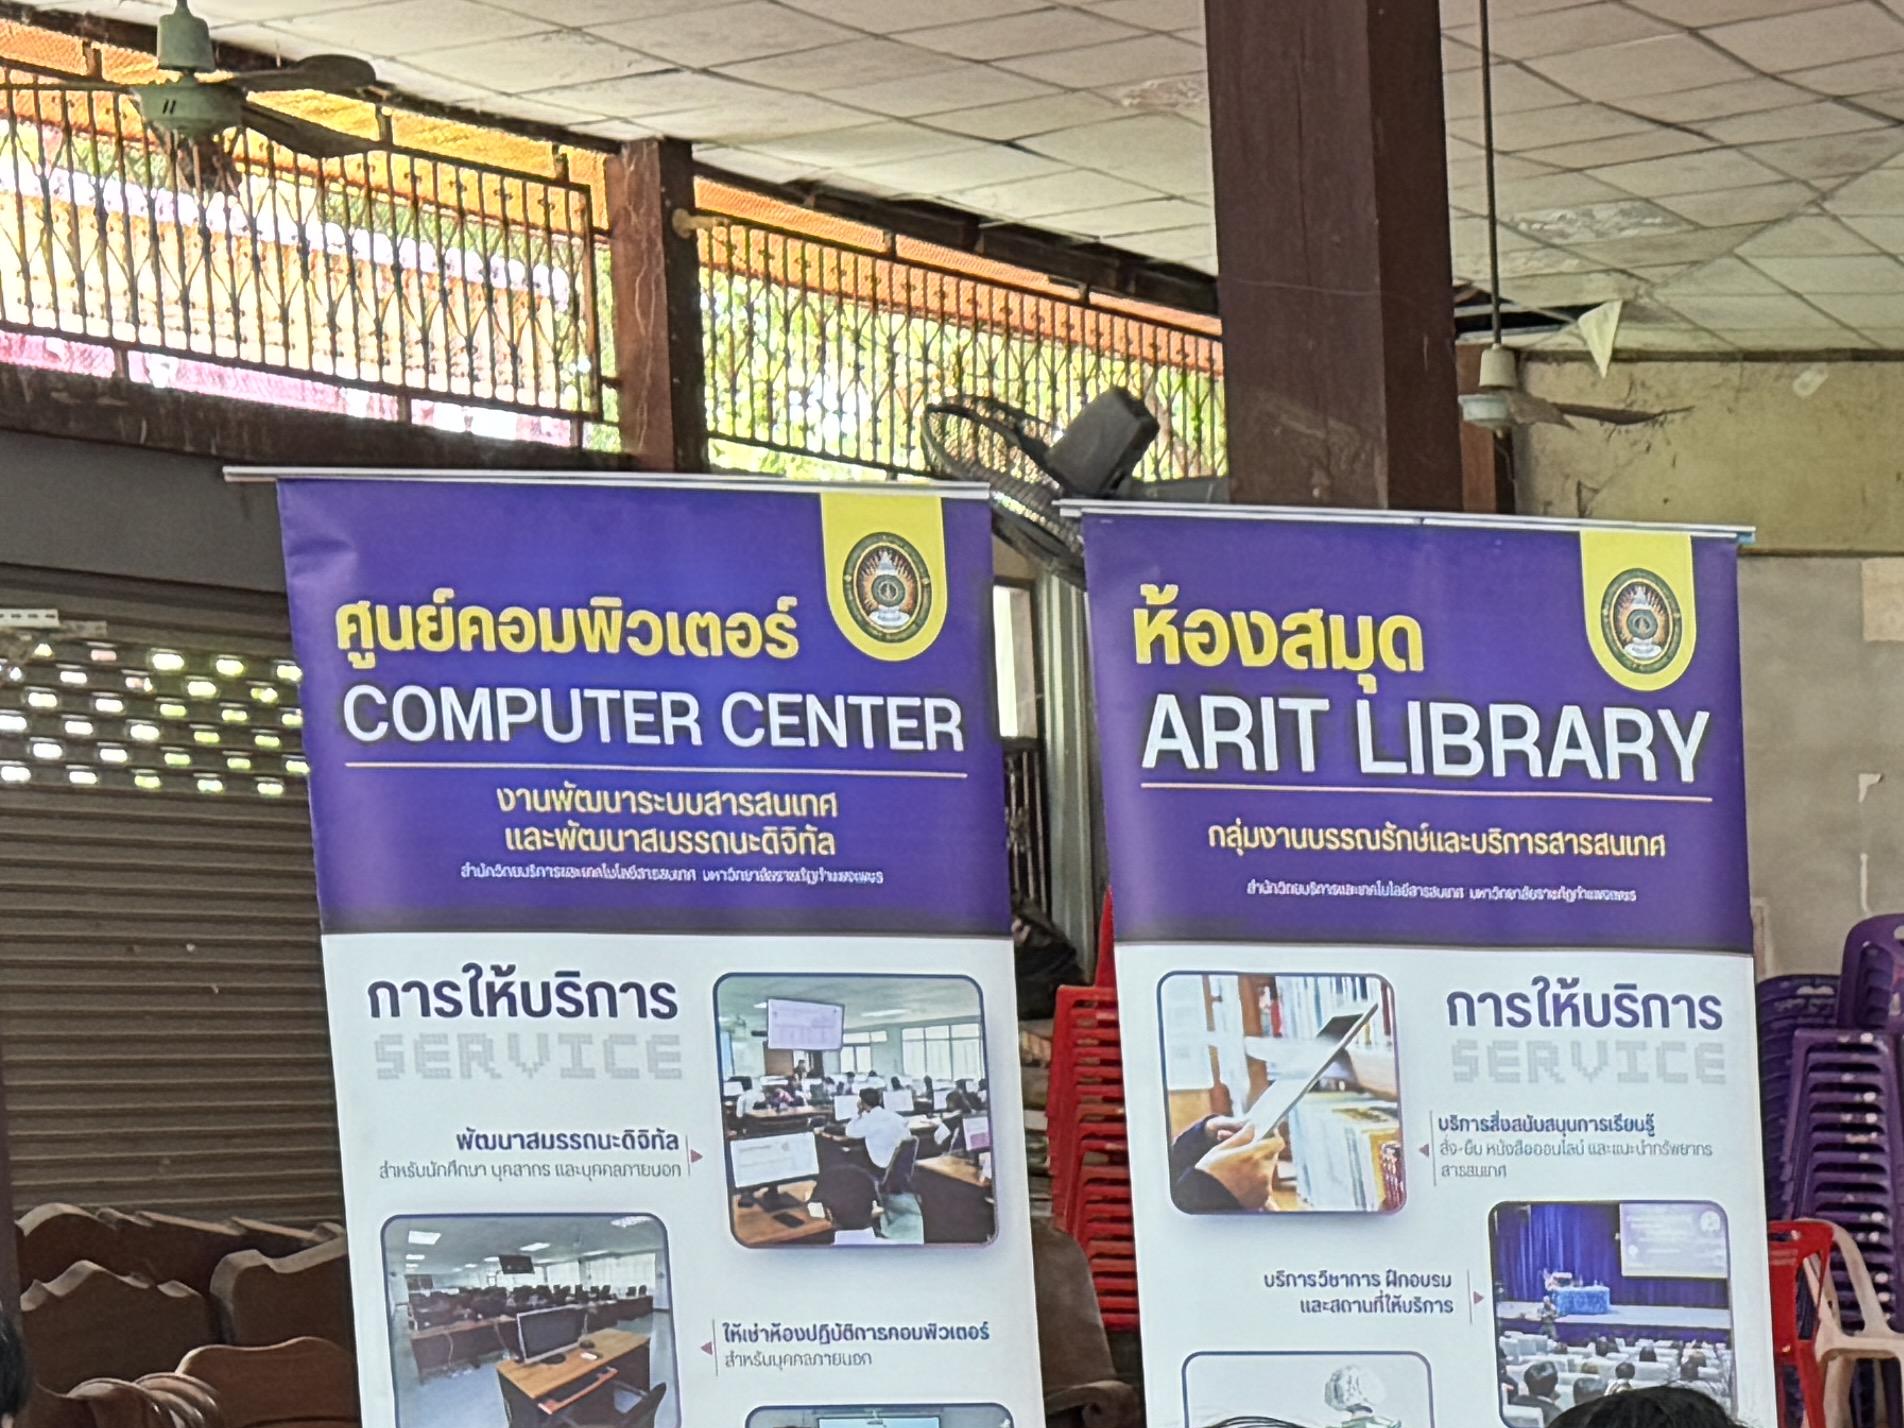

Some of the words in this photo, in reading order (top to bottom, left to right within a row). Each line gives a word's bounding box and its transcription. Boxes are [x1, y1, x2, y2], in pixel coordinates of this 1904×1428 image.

[335, 588, 799, 669] ศูนย์คอมพิวเตอร์
[1134, 584, 1425, 694] ห้องสมุด
[343, 685, 702, 746] COMPUTER
[721, 691, 965, 753] CENTER
[1142, 694, 1330, 773] ARIT
[1357, 698, 1711, 784] LIBRARY
[496, 780, 839, 818] งานพัฒนาระบบสารสนเทศ
[505, 819, 836, 856] และพัฒนาสมรรถนะดิจิทัล
[1208, 817, 1666, 859] กลุ่มงานบรรณรักษ์และบริการสารสนเทศ
[367, 962, 679, 1021] การให้บริการ
[1446, 976, 1724, 1032] การให้บริการ
[374, 1031, 684, 1081] SERVICE
[1451, 1038, 1727, 1085] SERVICE
[456, 1127, 680, 1151] พัฒนาสมรรถนะดิจิทัล
[1263, 1270, 1382, 1288] บริการวิชาการ
[1386, 1268, 1452, 1288] ฝึกอบรม
[1300, 1290, 1454, 1314] และสถานที่ให้บริการ
